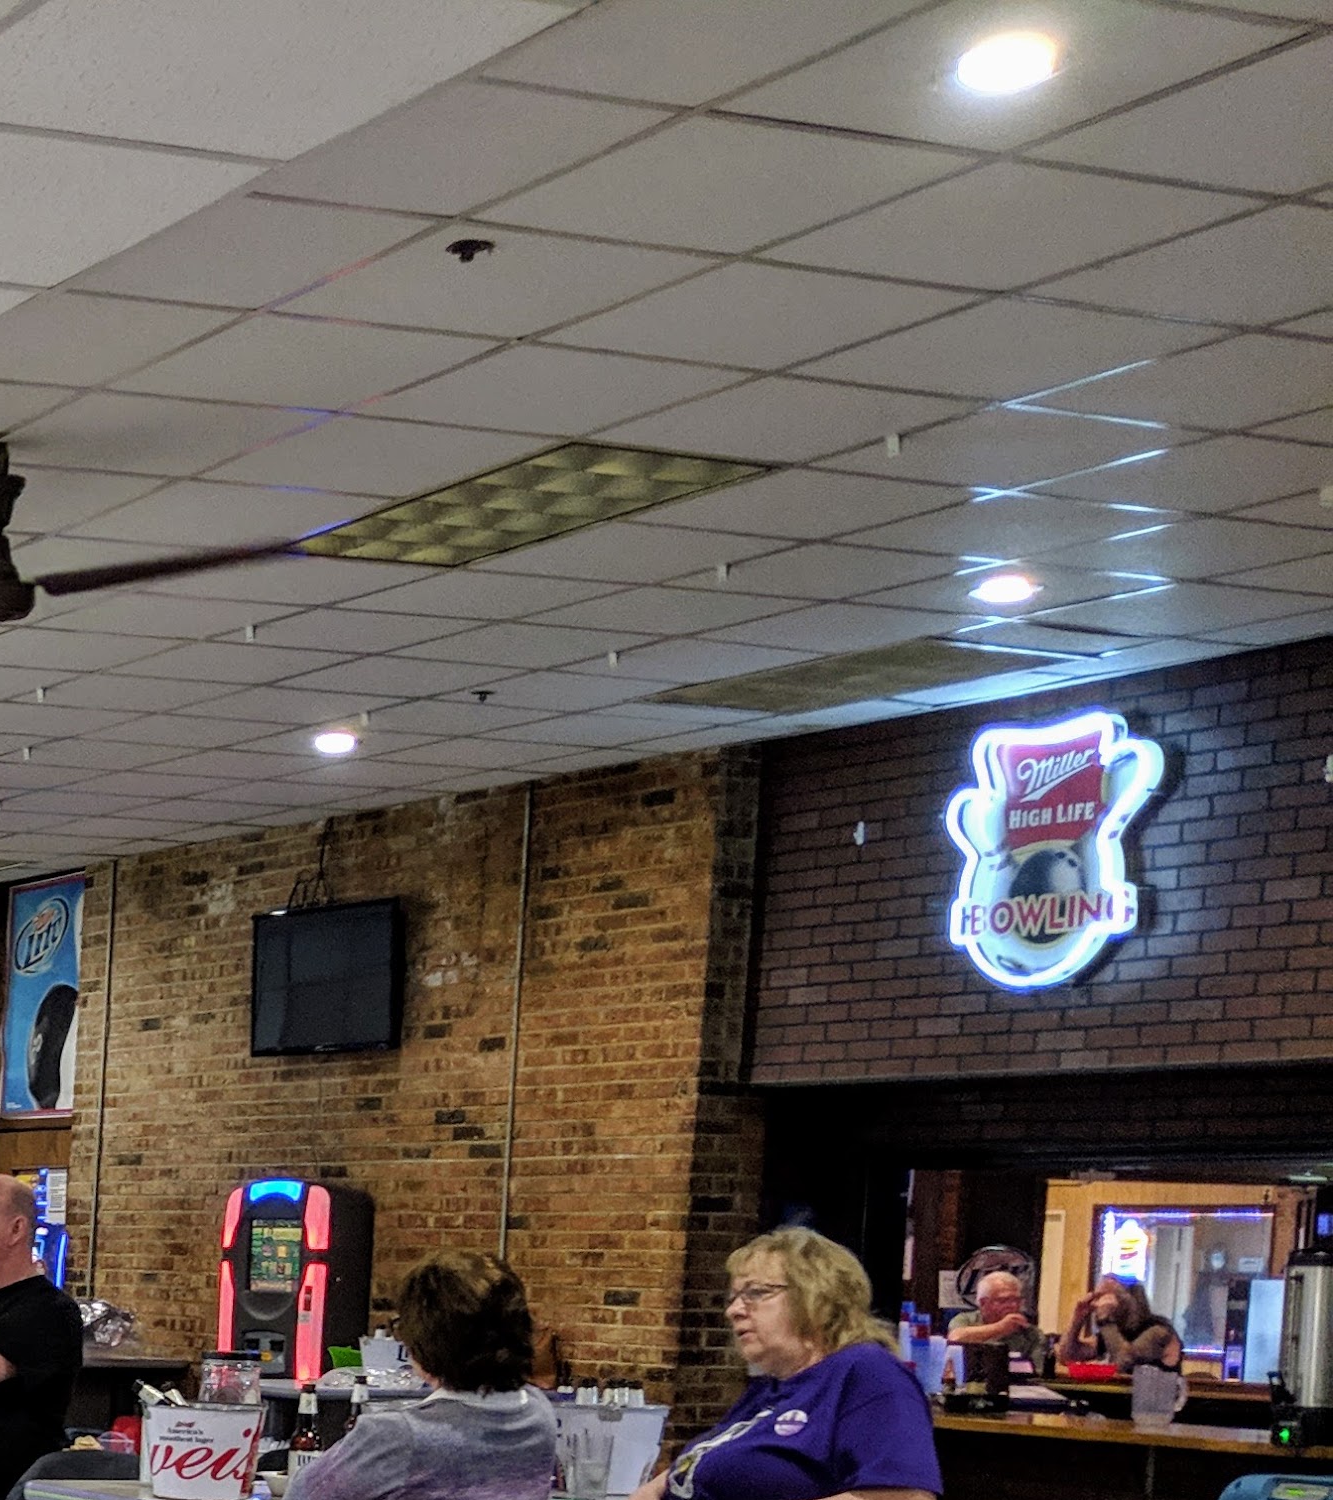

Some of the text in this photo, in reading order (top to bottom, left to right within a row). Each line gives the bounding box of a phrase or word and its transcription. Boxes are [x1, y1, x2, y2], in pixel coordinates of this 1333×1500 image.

[1017, 748, 1097, 796] Miller
[1009, 801, 1095, 829] HIGH LIFE
